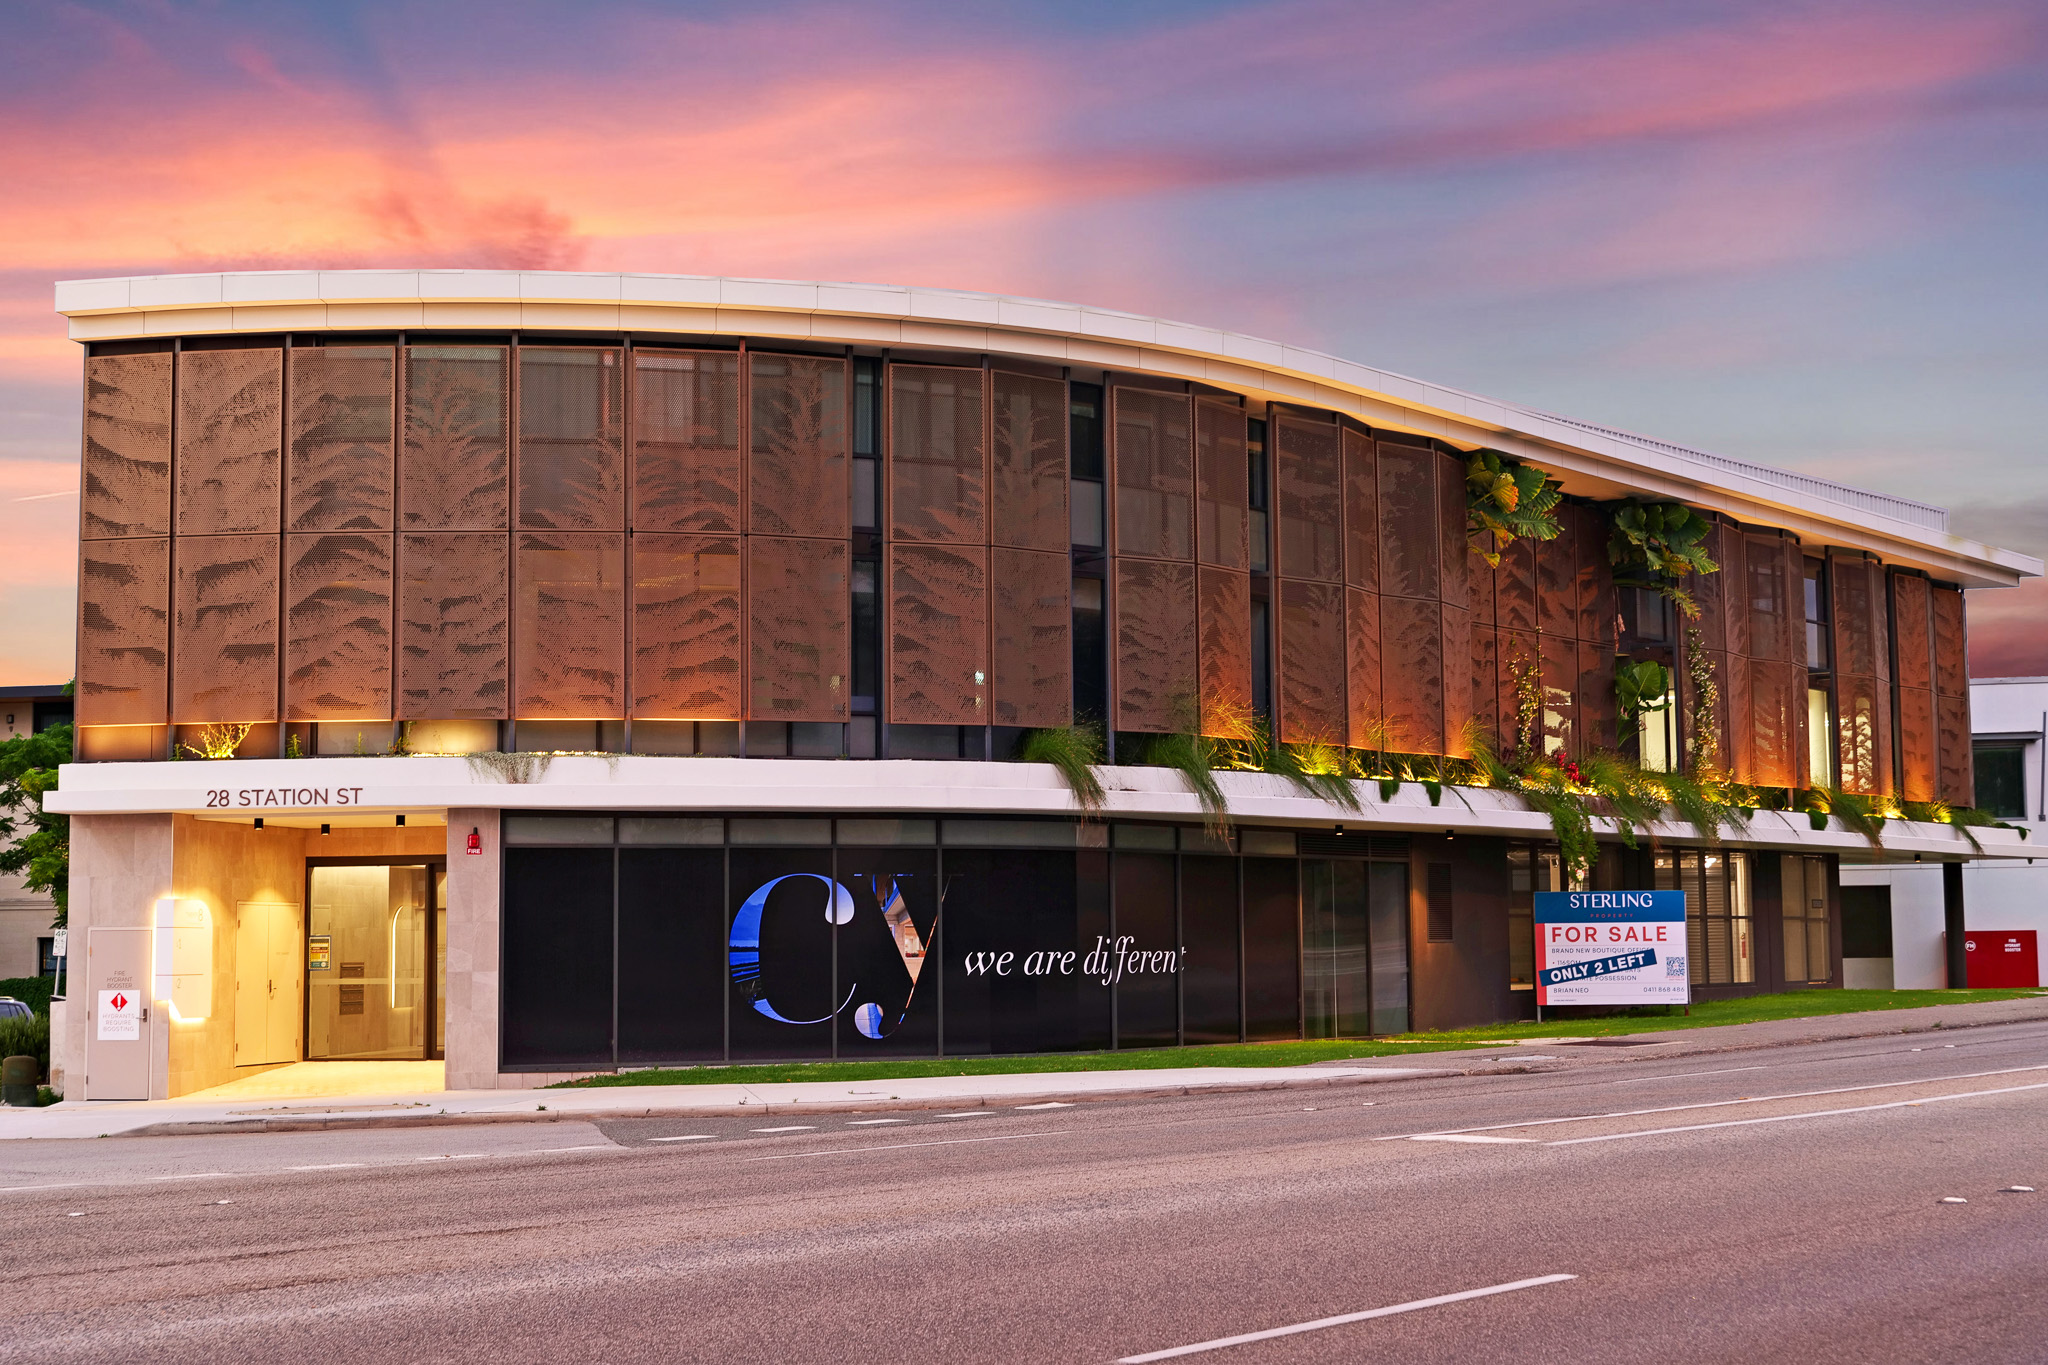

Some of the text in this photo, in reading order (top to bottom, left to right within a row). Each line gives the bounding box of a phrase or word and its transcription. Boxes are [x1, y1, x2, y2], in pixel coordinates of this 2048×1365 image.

[206, 787, 363, 808] 28 STATION ST
[1569, 892, 1653, 909] STERLING
[1551, 925, 1668, 943] FOR SALE
[1551, 947, 1575, 955] BRAND
[1592, 946, 1625, 954] BOUTIQUE
[964, 951, 1015, 976] we
[1023, 950, 1077, 976] are
[1550, 953, 1646, 983] ONLY 2 LEFT
